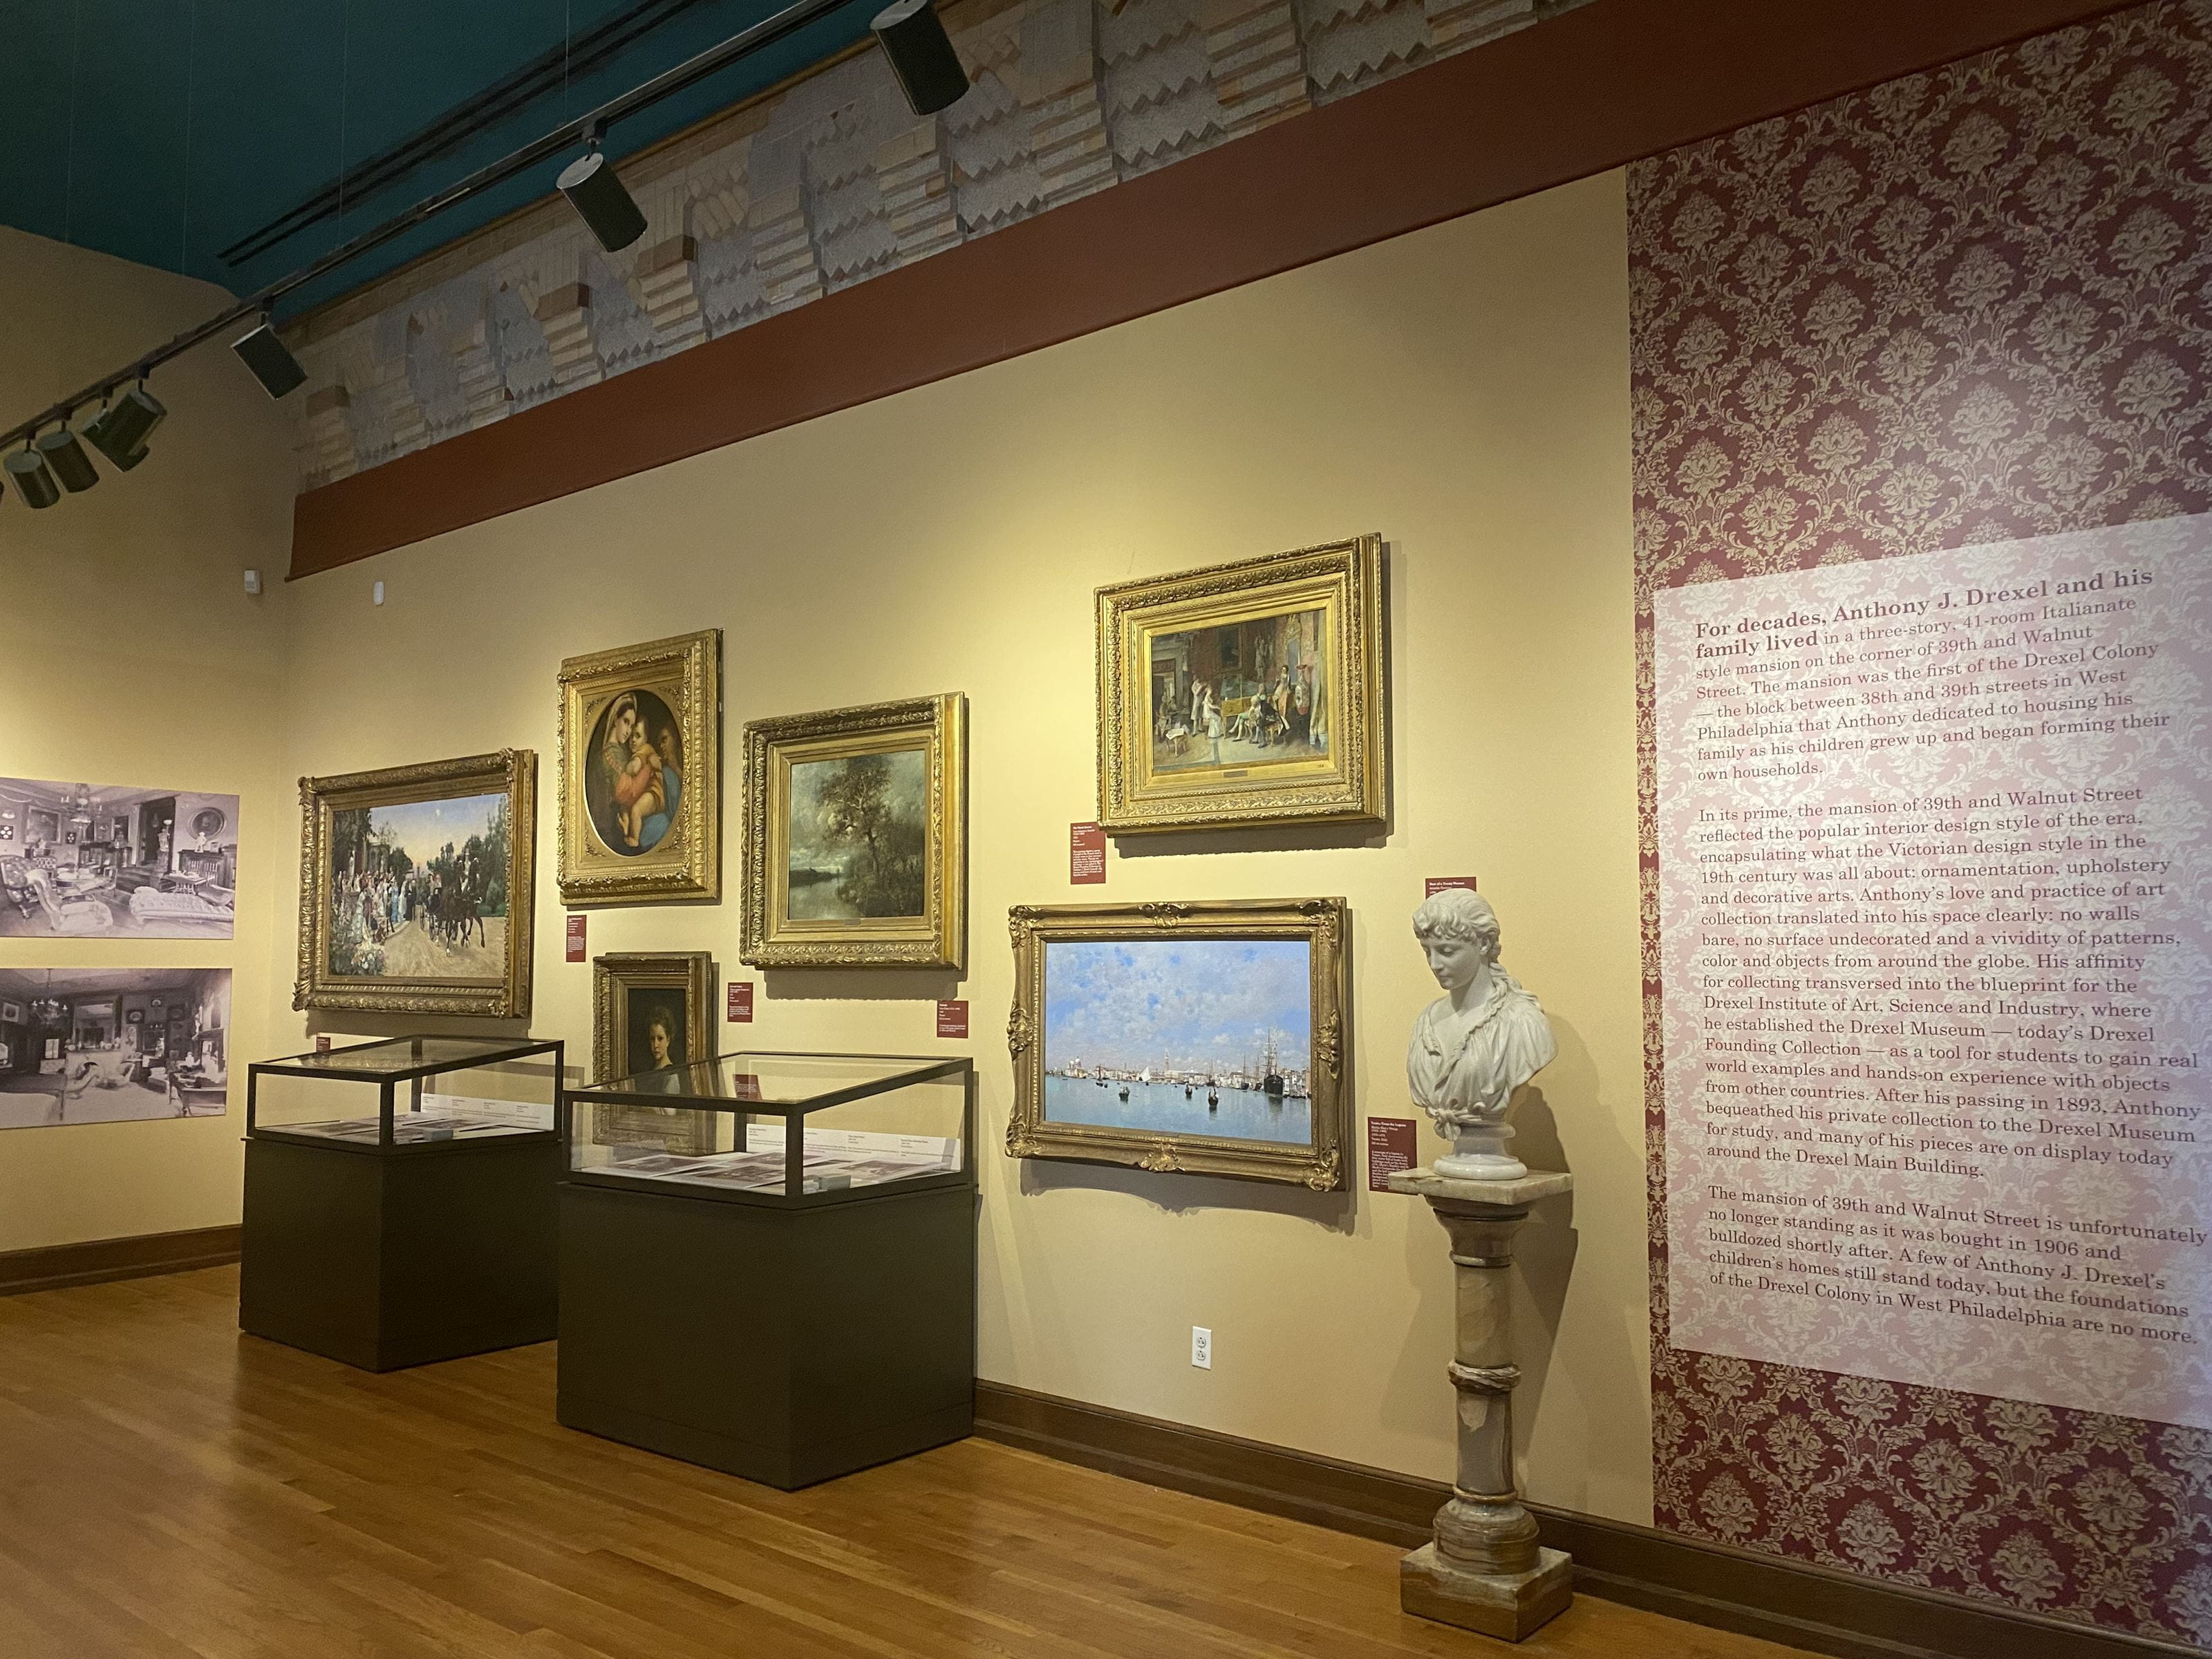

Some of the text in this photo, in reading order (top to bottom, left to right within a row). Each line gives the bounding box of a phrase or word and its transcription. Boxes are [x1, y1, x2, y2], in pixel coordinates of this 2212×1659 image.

[1696, 568, 2154, 638] For decades, Anthony J. Drexel and his
[1696, 599, 2137, 659] family lived in a three-story, 41-room Italianate
[1696, 626, 2093, 681] style mansion on the corner of 39th and Walnut
[1696, 643, 2159, 700] Street. The mansion was the first of the Drexel Colony
[1697, 691, 2133, 740] Philadelphia that Anthony dedicated to housing his
[1717, 704, 1741, 718] the
[1745, 699, 1785, 715] block
[1789, 697, 1855, 711] between
[1861, 688, 1898, 705] 38th
[1903, 685, 1936, 702] and
[1940, 681, 1980, 698] 39th
[1985, 677, 2048, 694] streets
[2054, 673, 2072, 688] in
[2078, 669, 2127, 686] West
[1697, 711, 2171, 761] family as his children grew up and began forming their
[1697, 760, 1823, 781] own households.
[1698, 787, 2144, 823] In its prime, the mansion of 39th and Walnut Street
[1702, 857, 2171, 885] 19th century was all about: ornamentation, upholstery
[1703, 995, 2152, 1019] Drexel Institute of Art, Science and Industry, where
[1705, 1100, 2195, 1143] bequeathed his private collection to the Drexel Museum
[1707, 1184, 2208, 1247] The mansion of 39th and Walnut Street is unfortunately
[1709, 1208, 2121, 1260] no longer standing as it was bought in 1906 and
[1709, 1227, 1781, 1248] bulldozed
[1787, 1236, 1843, 1257] shortly
[1848, 1243, 1893, 1260] after.
[1898, 1247, 1913, 1263] A
[1918, 1249, 1947, 1266] few
[1953, 1254, 1971, 1268] of
[1975, 1255, 2054, 1277] Anthony
[2060, 1264, 2078, 1280] J.
[1709, 1271, 2197, 1343] of the Drexel Colony in West Philadelphia are no more.
[1788, 1257, 1839, 1277] homes
[1844, 1266, 1877, 1281] still
[1882, 1272, 1930, 1287] stand
[1936, 1276, 1990, 1295] today,
[1996, 1280, 2028, 1298] but
[2034, 1286, 2065, 1302] the
[2070, 1289, 2189, 1316] foundations
